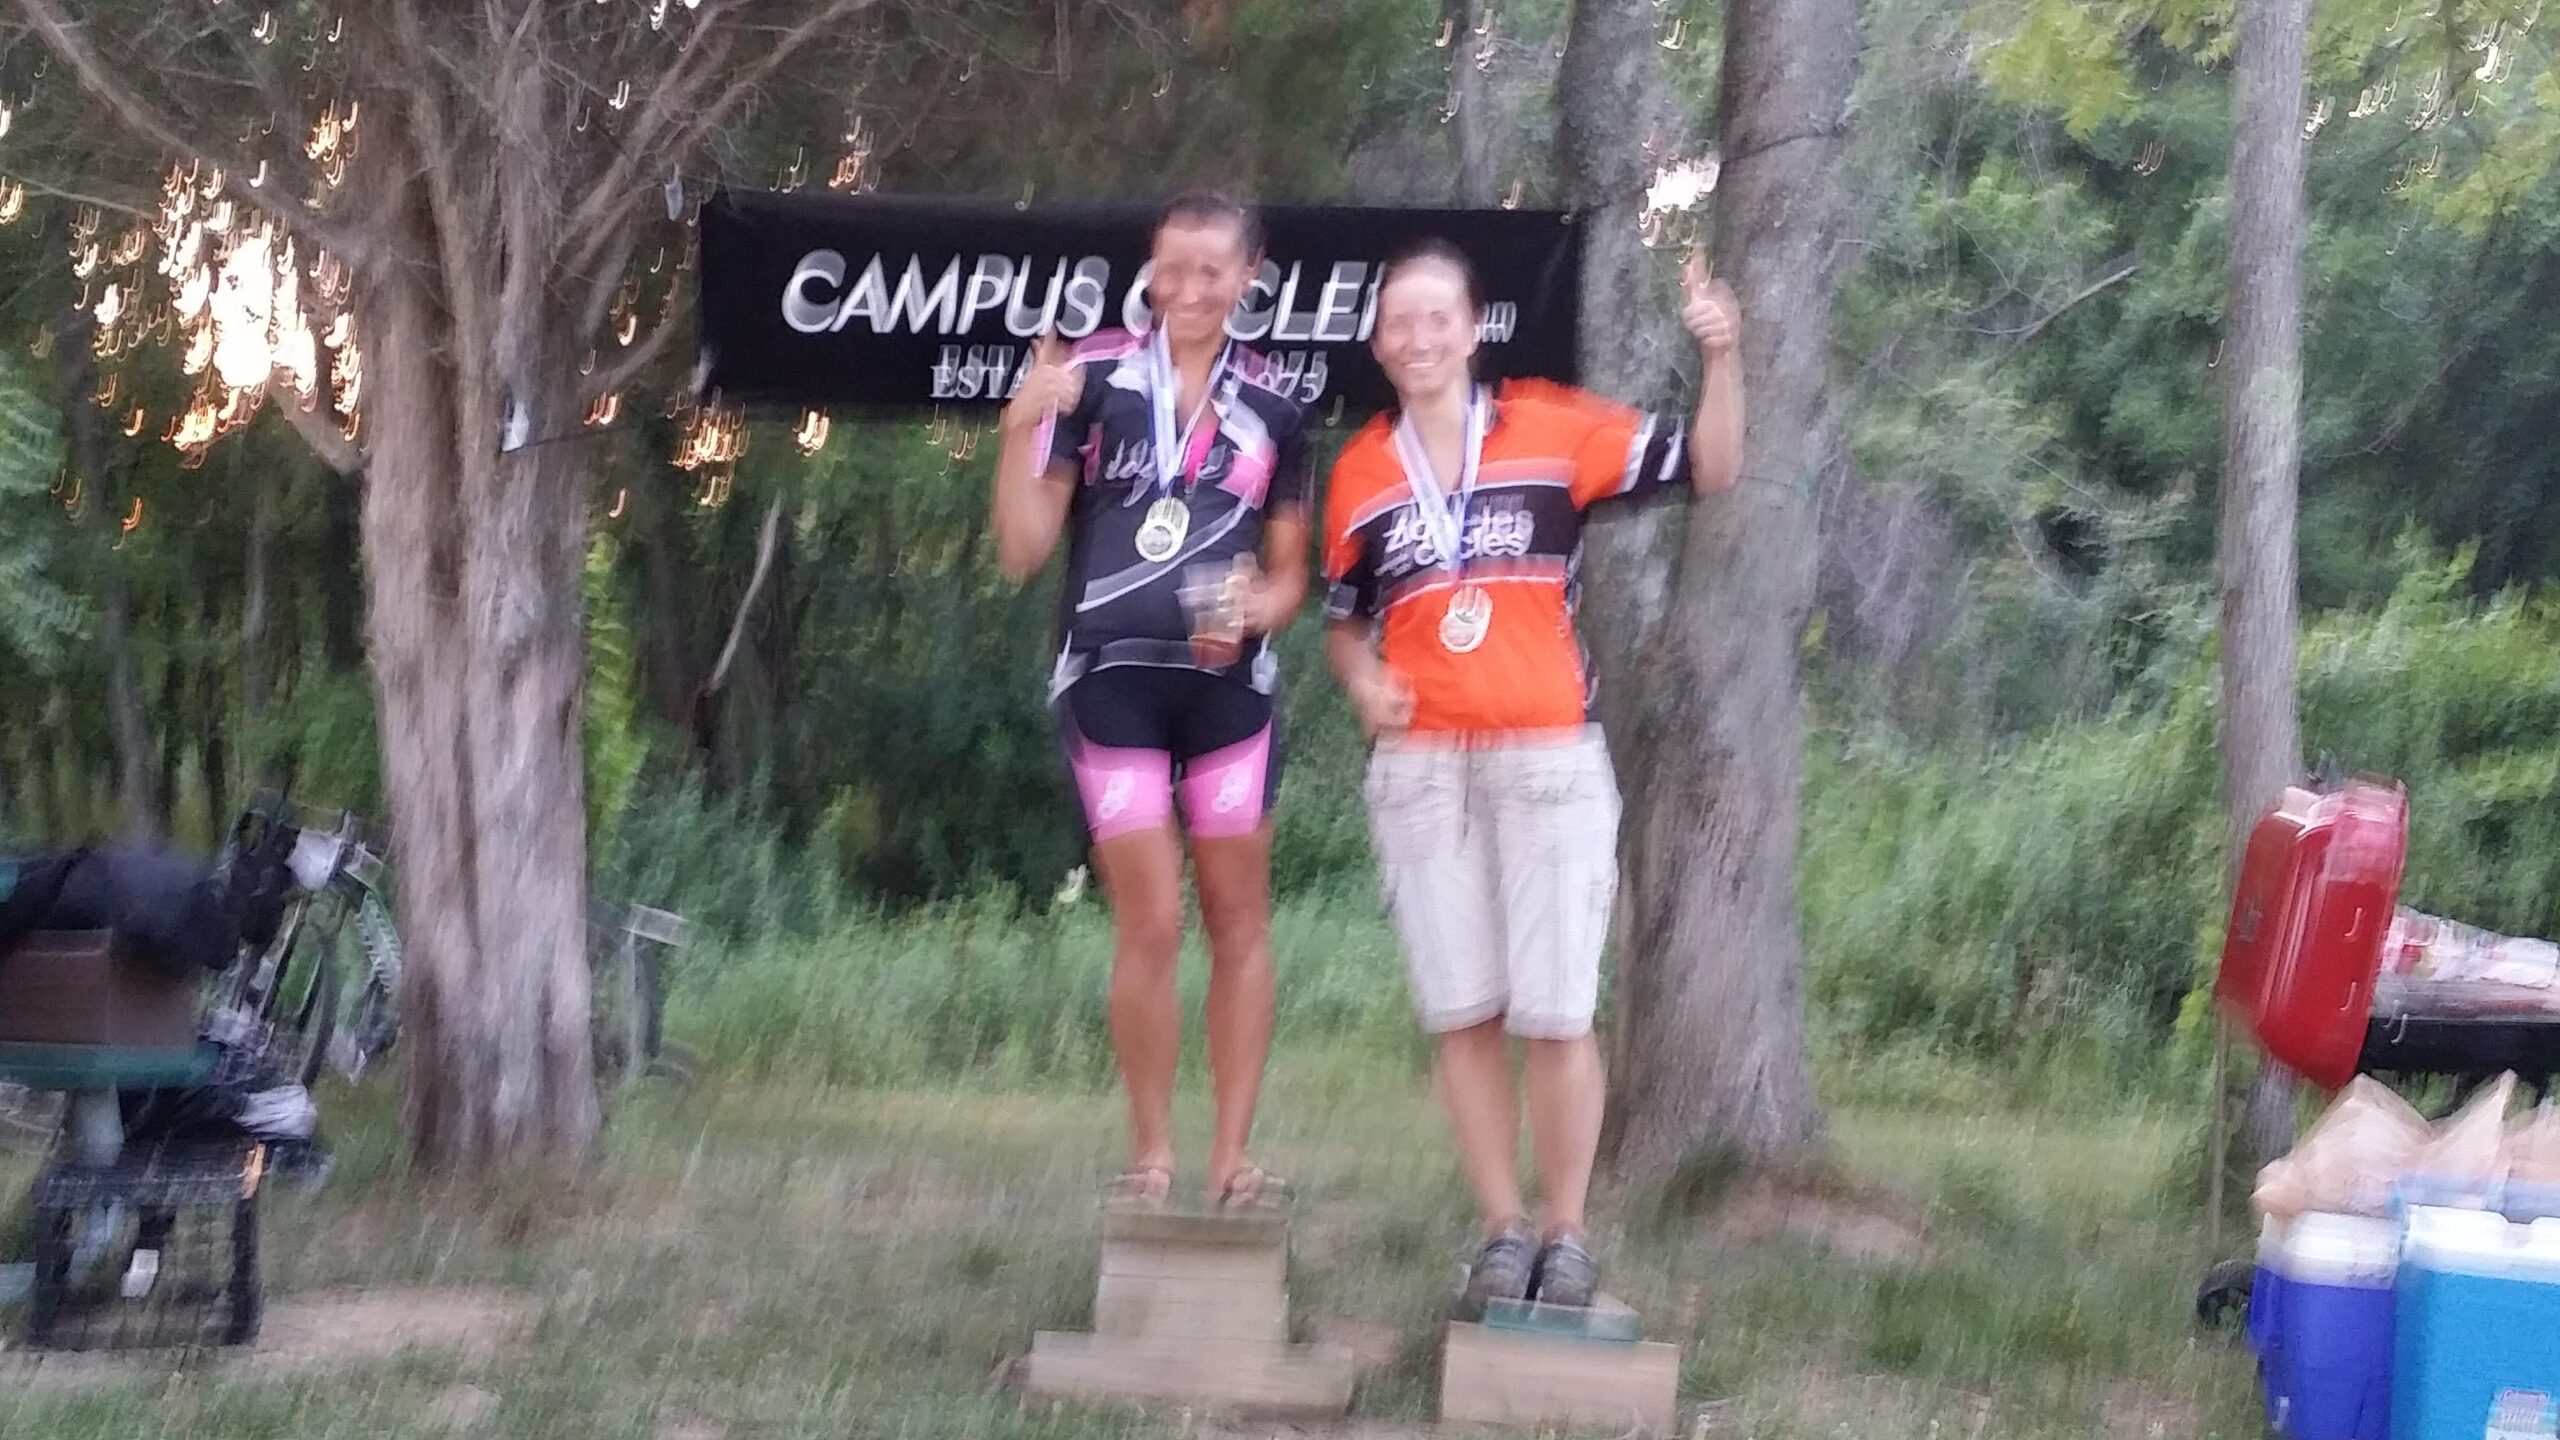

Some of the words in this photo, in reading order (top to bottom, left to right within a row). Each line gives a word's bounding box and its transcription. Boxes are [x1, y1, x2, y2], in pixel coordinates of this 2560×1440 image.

[781, 249, 1109, 338] CAMPUS
[1122, 256, 1384, 342] CCLE
[1254, 350, 1329, 404] 975
